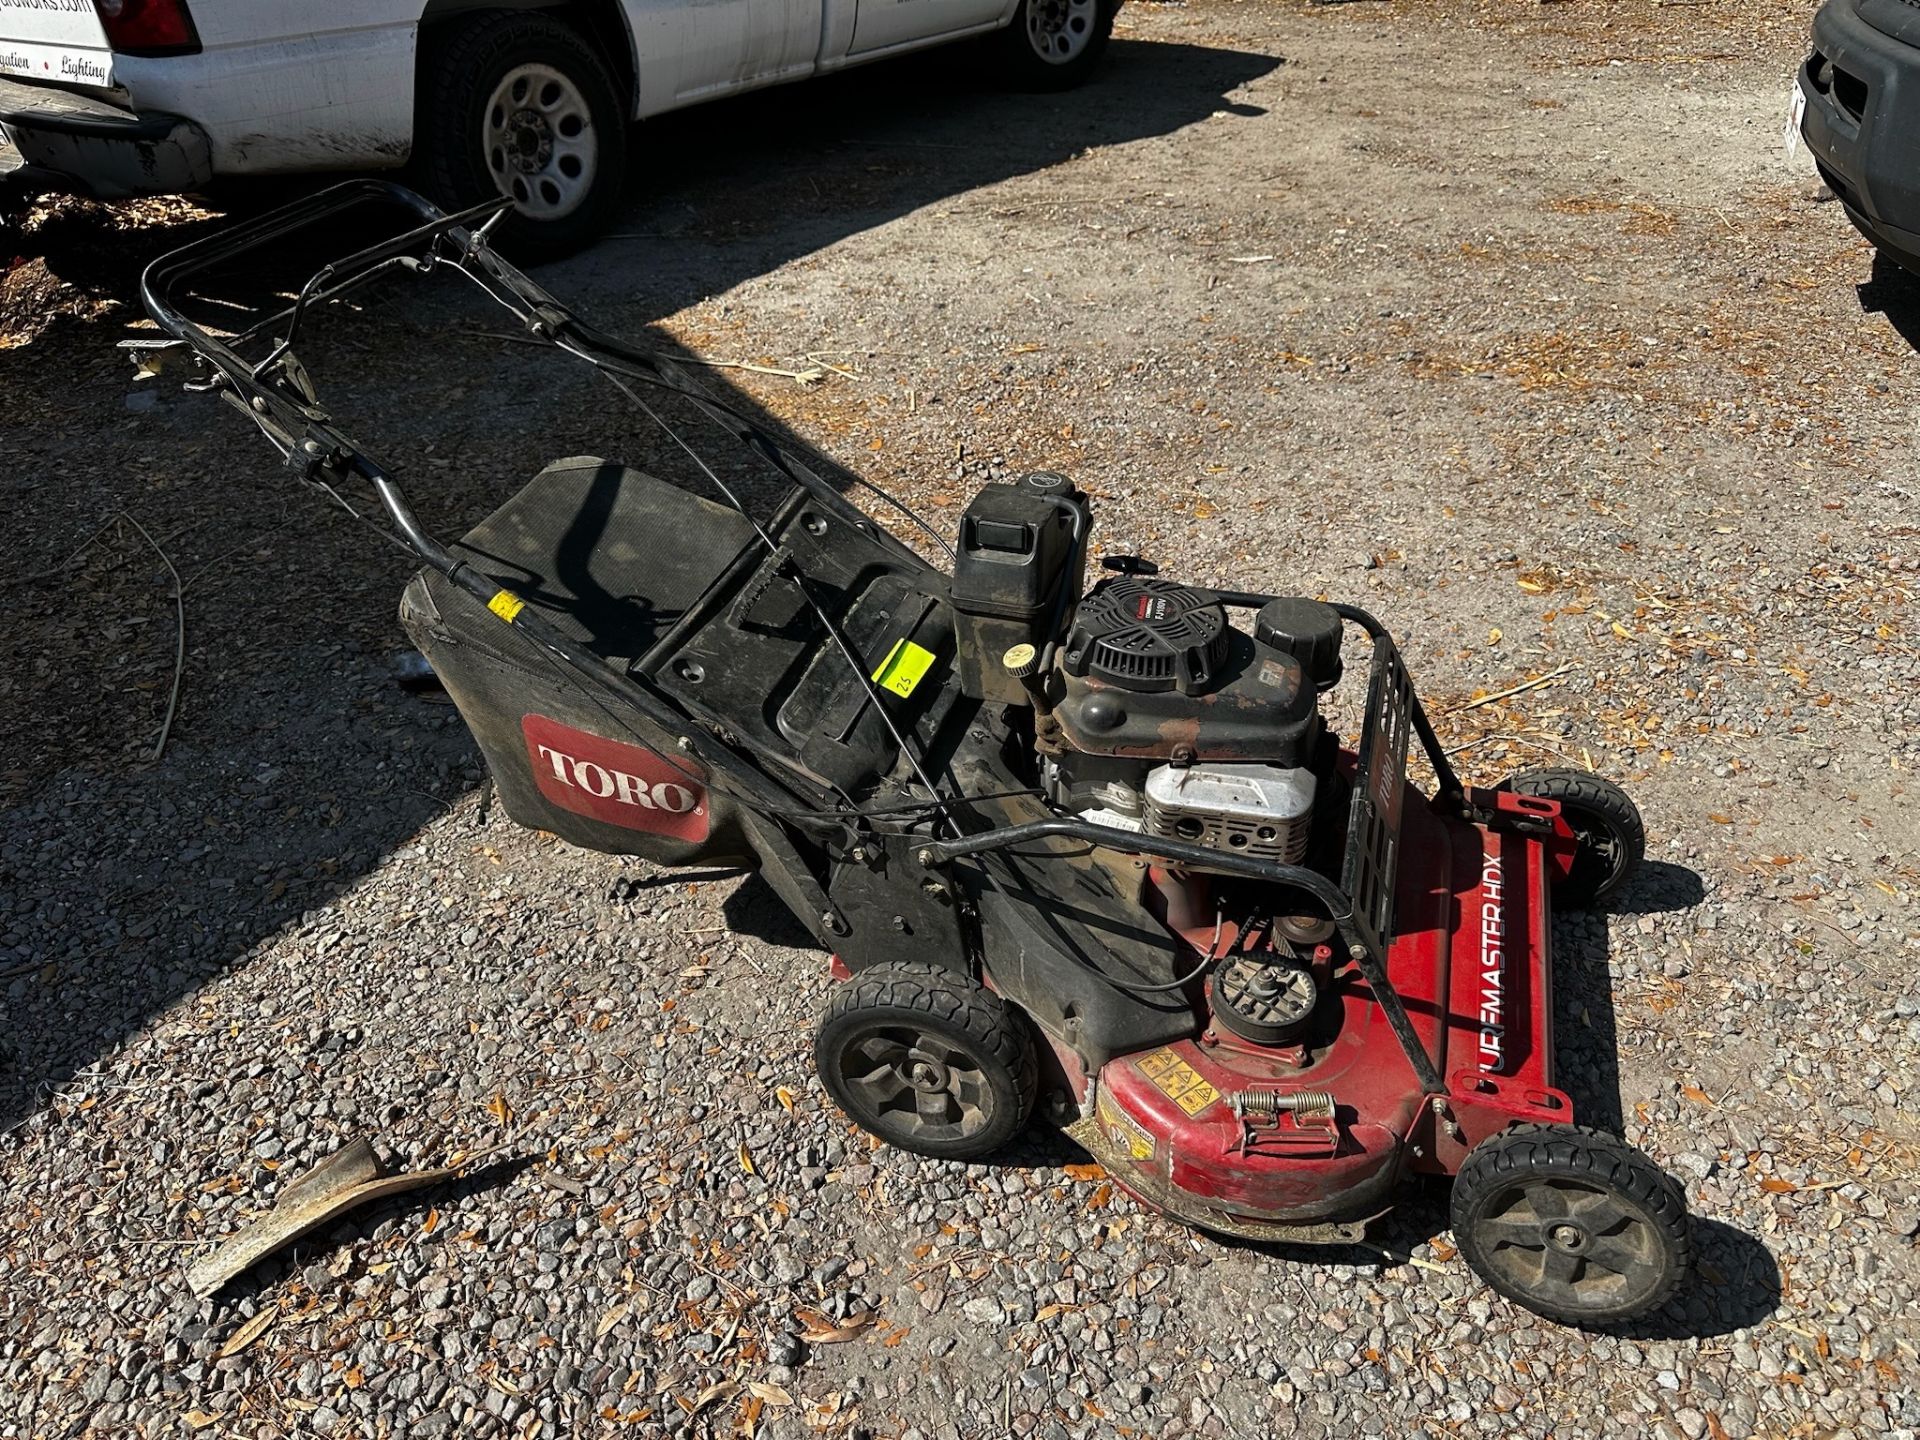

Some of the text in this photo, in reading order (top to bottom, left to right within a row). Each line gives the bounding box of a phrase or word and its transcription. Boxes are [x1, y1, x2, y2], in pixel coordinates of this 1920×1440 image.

[61, 55, 105, 84] Lighting
[896, 675, 912, 692] 25
[537, 744, 696, 813] TORO
[1482, 853, 1505, 901] HDX
